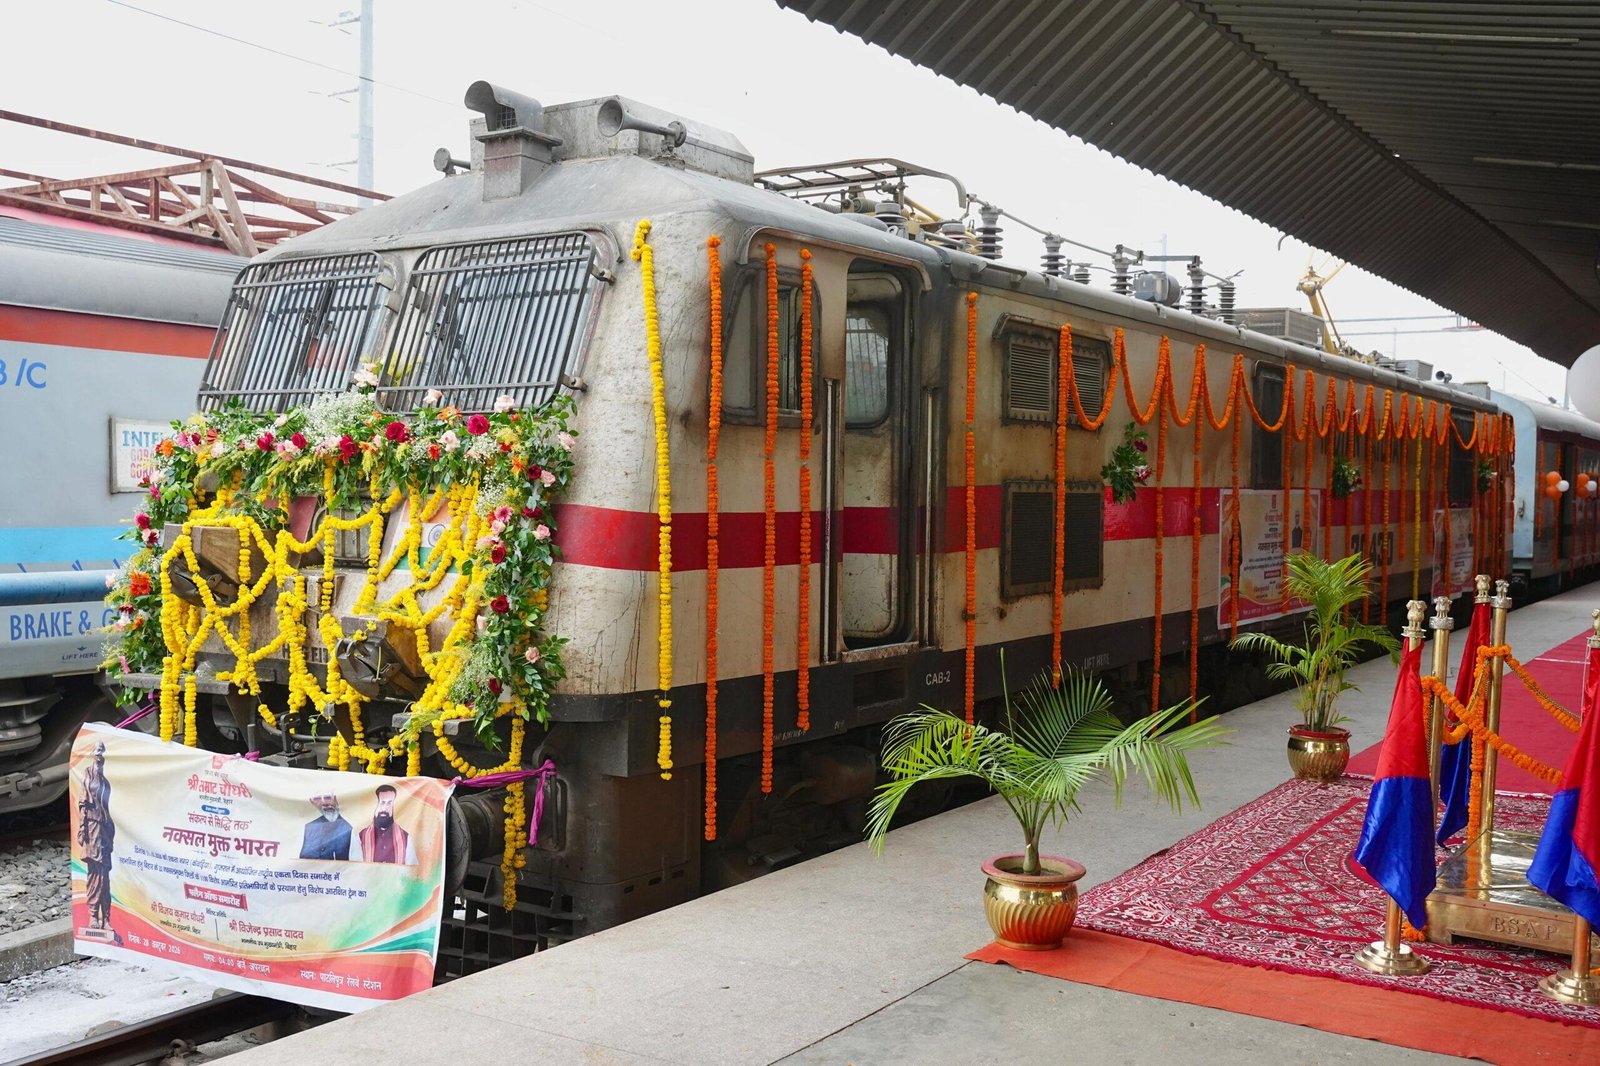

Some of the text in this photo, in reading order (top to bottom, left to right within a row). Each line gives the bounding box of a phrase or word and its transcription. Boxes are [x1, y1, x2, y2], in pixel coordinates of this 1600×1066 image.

[122, 430, 164, 447] INTE
[10, 610, 73, 641] BRAKE
[78, 609, 91, 635] &
[62, 653, 78, 661] LIFT
[925, 670, 951, 686] CAB-2
[162, 826, 280, 858] नक्सल मुक्त भारत
[274, 870, 292, 878] एकता
[292, 869, 309, 879] दिवस
[310, 871, 332, 881] समारोह
[269, 882, 276, 891] के
[297, 884, 307, 897] हेतु
[358, 890, 367, 898] का
[229, 919, 237, 932] श्री
[263, 926, 282, 937] प्रसाद
[284, 929, 304, 940] यादव
